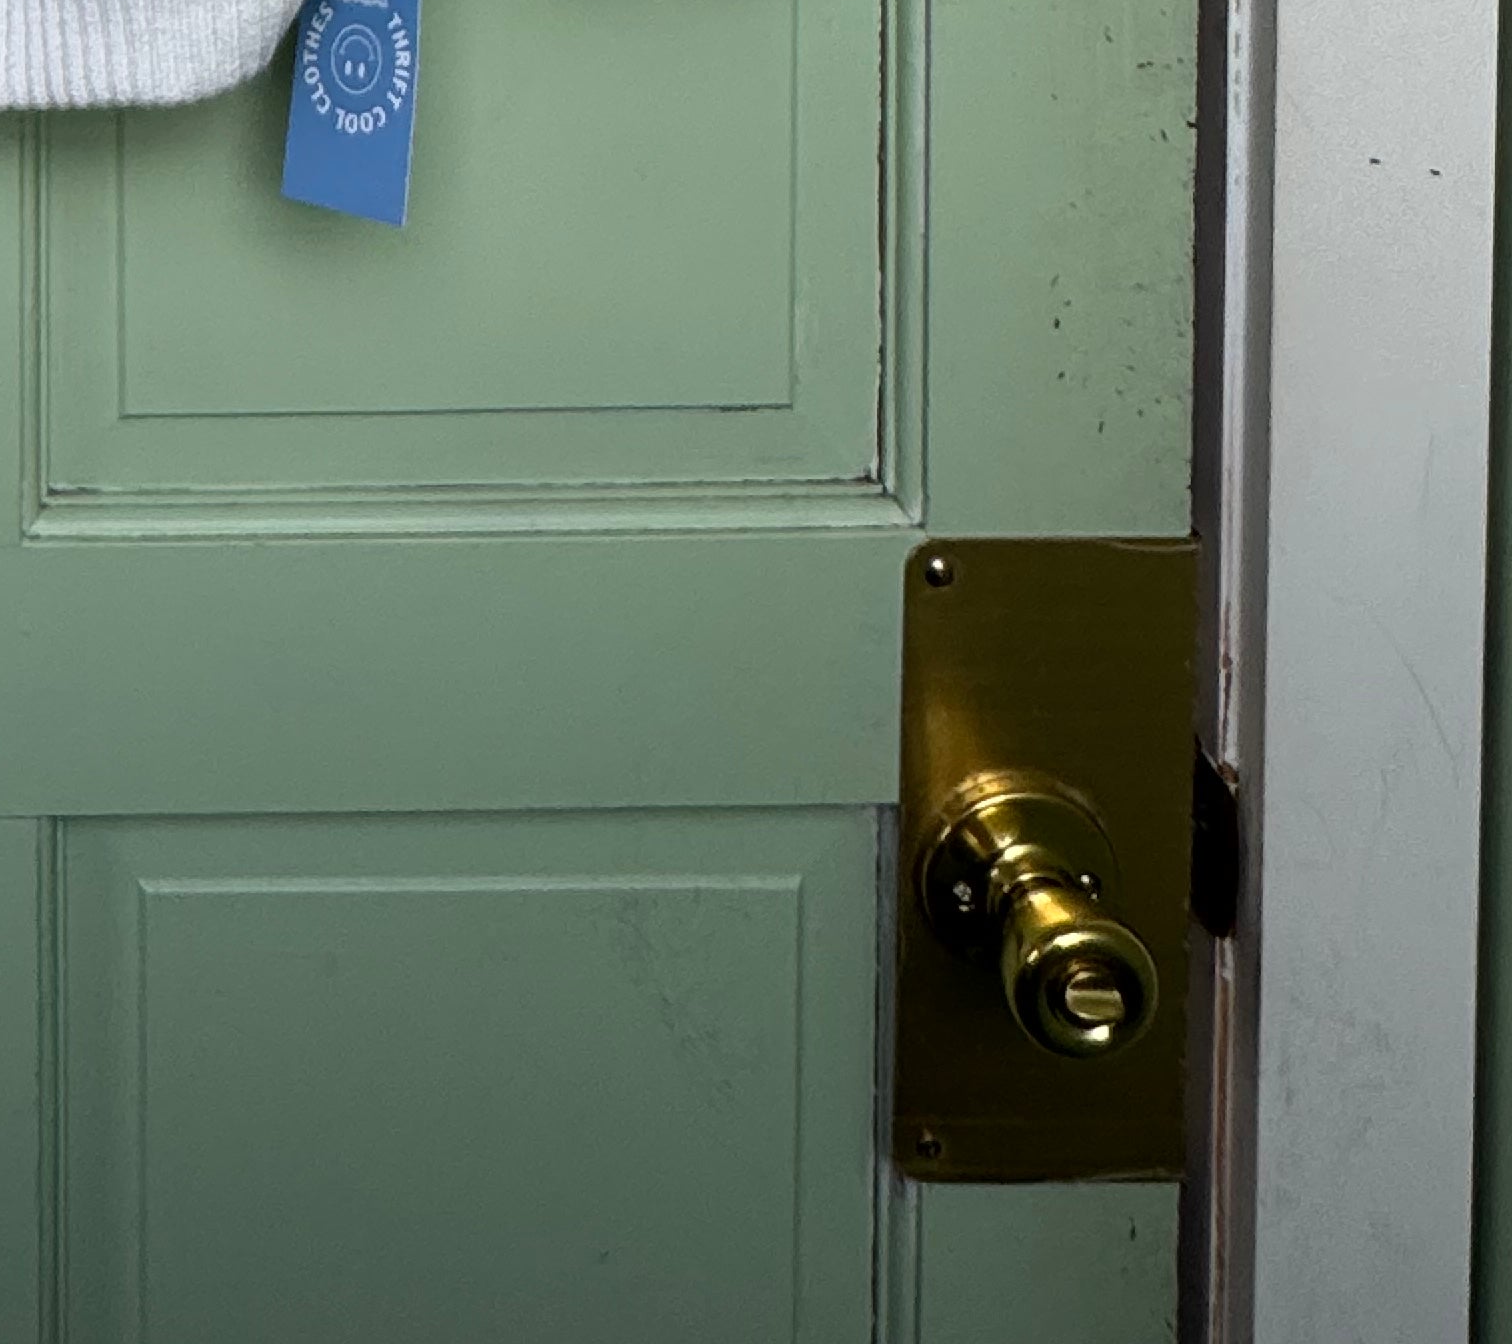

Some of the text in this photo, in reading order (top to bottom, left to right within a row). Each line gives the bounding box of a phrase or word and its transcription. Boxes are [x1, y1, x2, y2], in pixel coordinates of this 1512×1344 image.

[303, 1, 411, 133] THRIFT COOL CLOTHES
